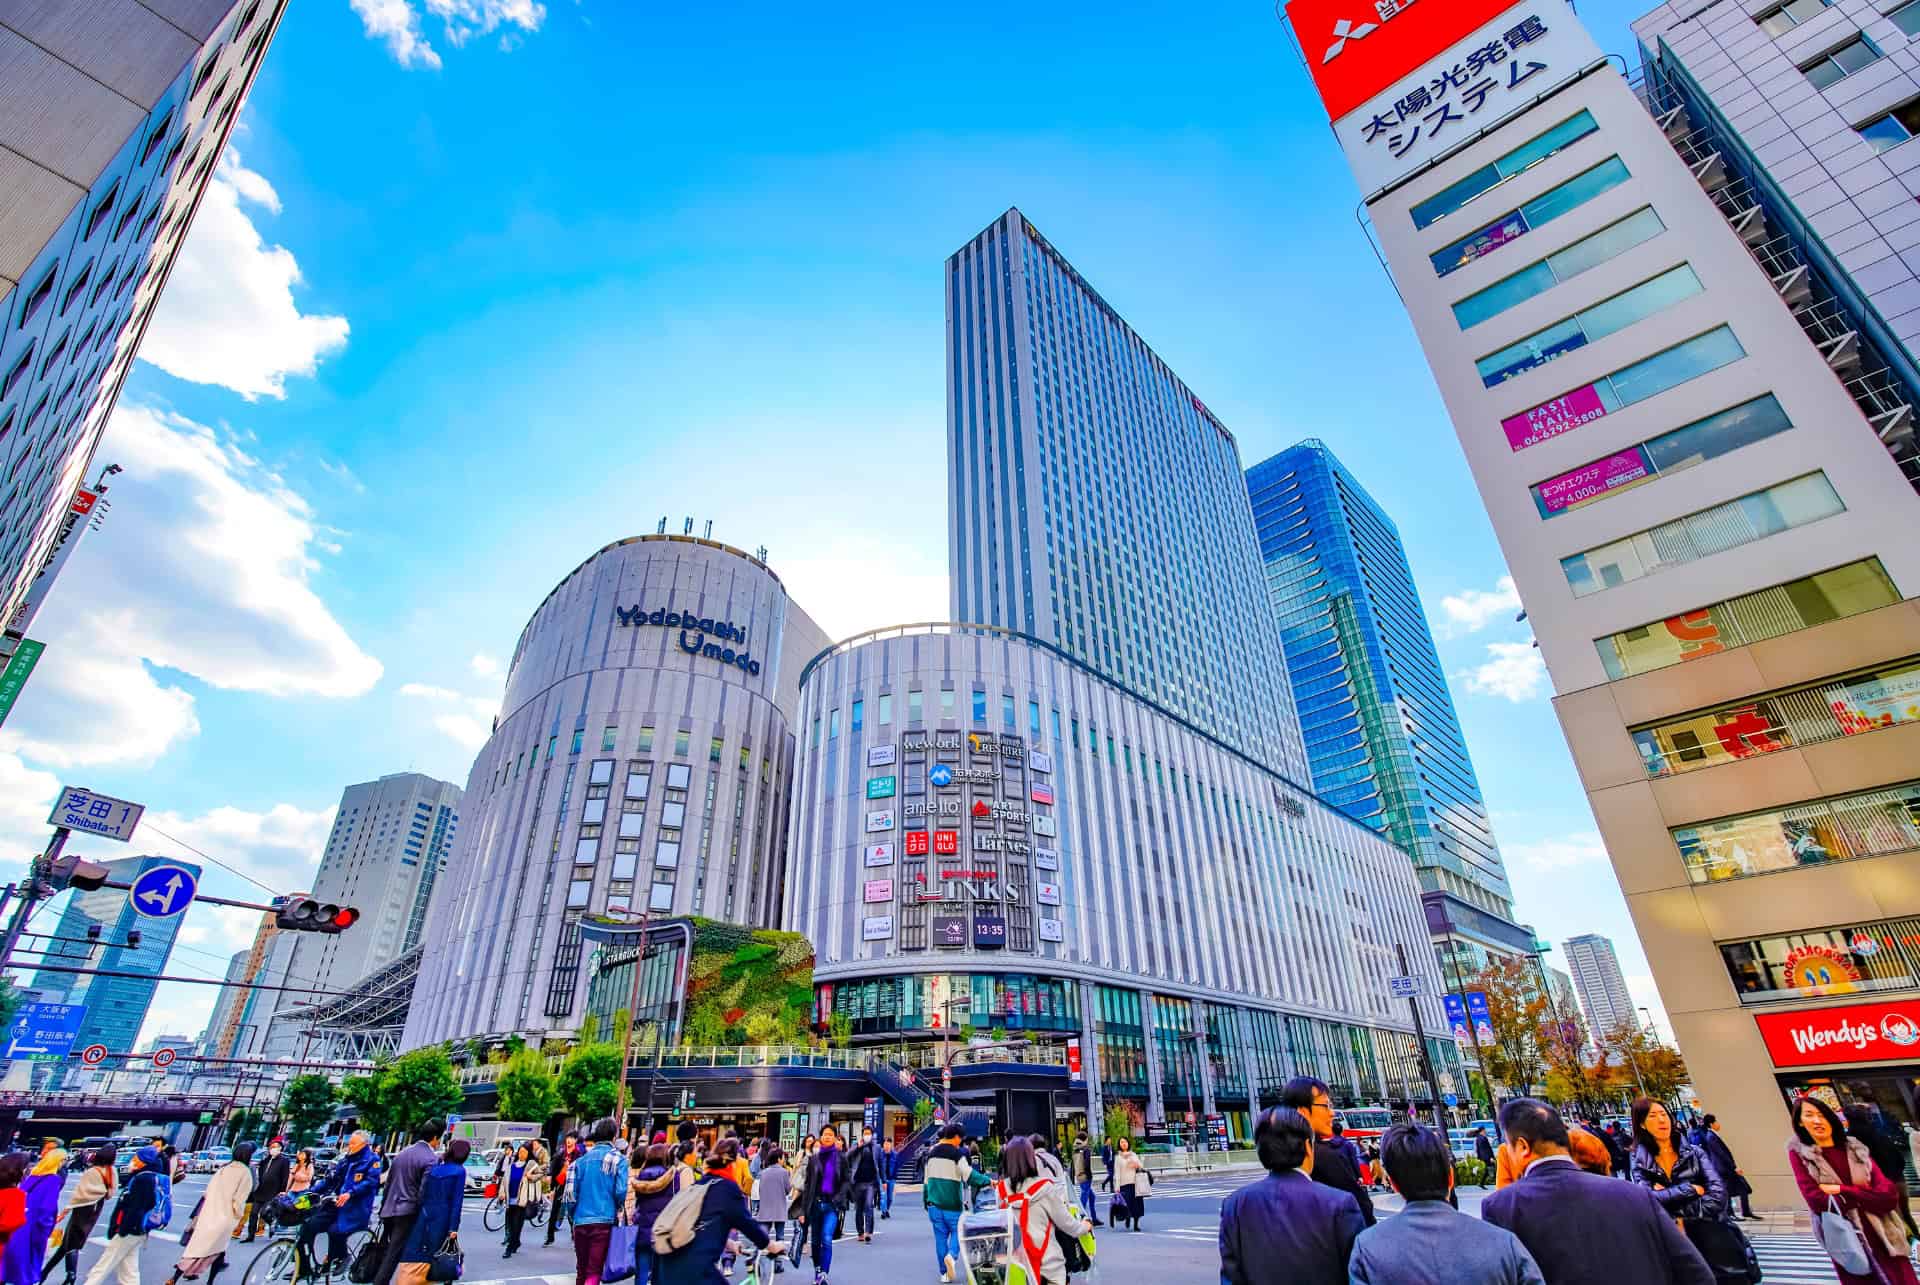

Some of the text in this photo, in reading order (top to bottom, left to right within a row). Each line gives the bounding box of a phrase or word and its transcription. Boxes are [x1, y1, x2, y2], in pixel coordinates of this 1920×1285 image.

[1361, 15, 1548, 143] 太陽光発電
[1388, 60, 1547, 158] システム
[1528, 398, 1566, 421] FAST
[1533, 409, 1573, 432] NAIL
[617, 604, 746, 645] Yodobashi
[680, 630, 760, 676] Umeda
[63, 793, 130, 824] 芝田 1
[992, 800, 1012, 811] ART
[992, 809, 1030, 823] SPORTS
[65, 813, 120, 835] Shibata-1
[977, 924, 1003, 935] 13:35
[1791, 1019, 1877, 1054] Wendy's
